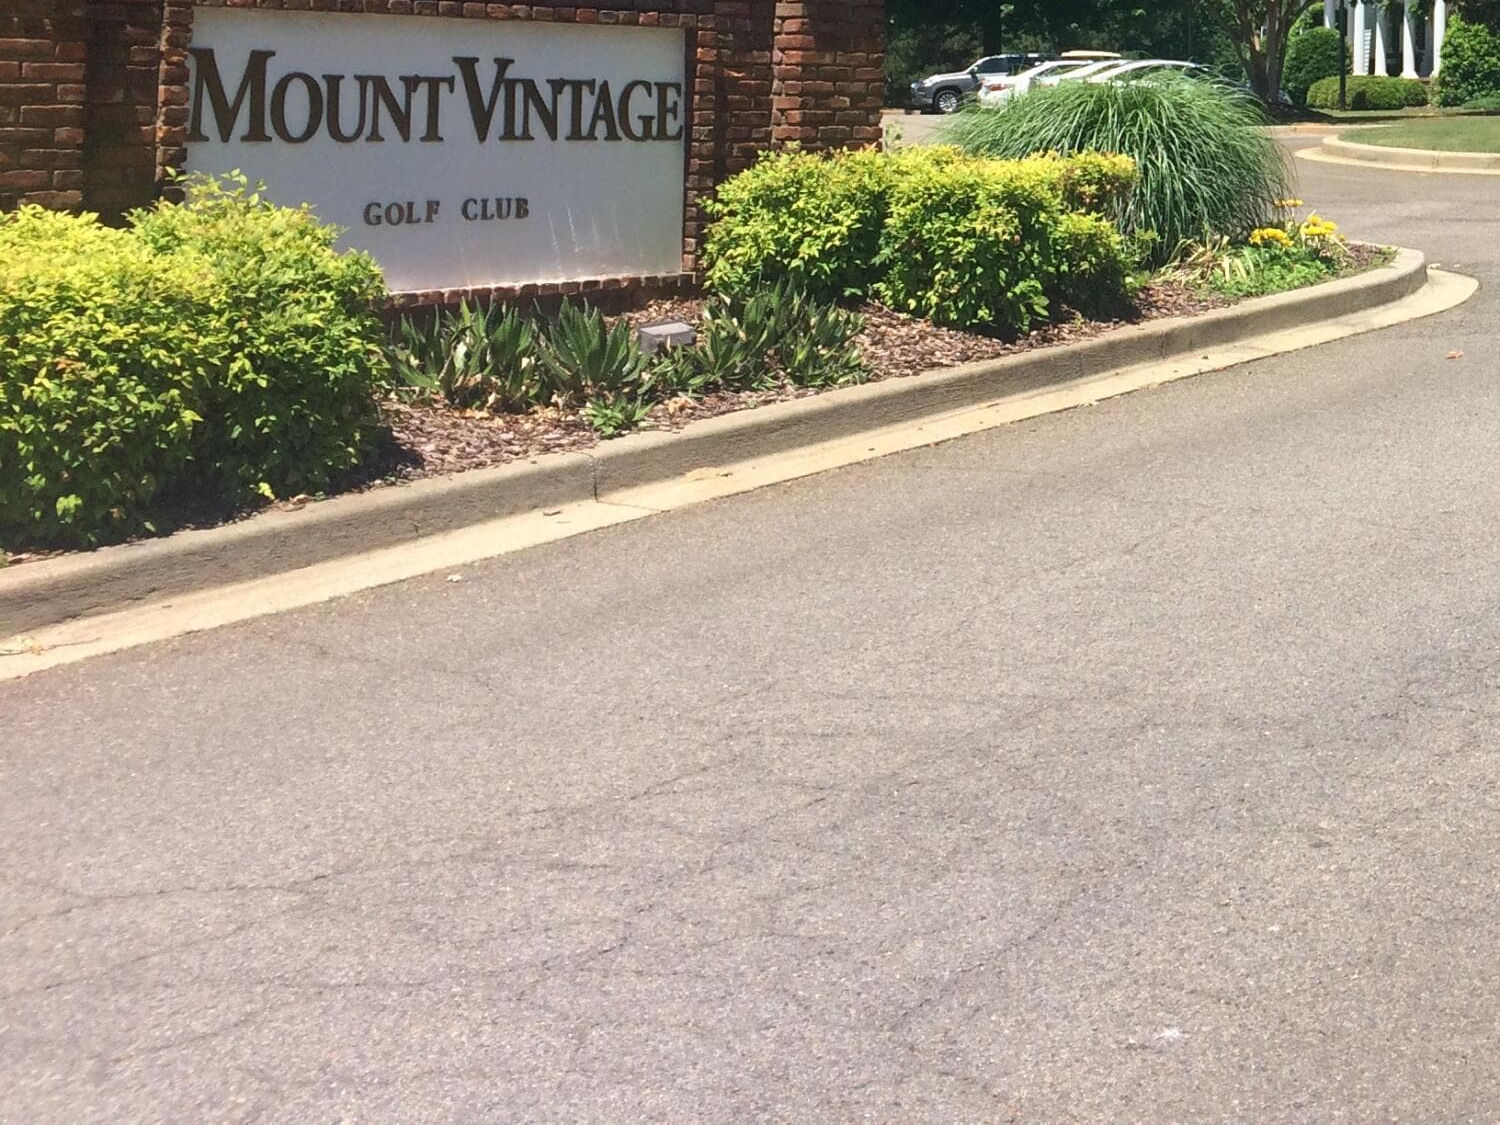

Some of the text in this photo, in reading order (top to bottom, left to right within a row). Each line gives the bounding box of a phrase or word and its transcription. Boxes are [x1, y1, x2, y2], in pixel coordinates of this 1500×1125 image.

[186, 47, 683, 144] MOUNT VINTAGE
[363, 197, 530, 226] GOLF CLUB
